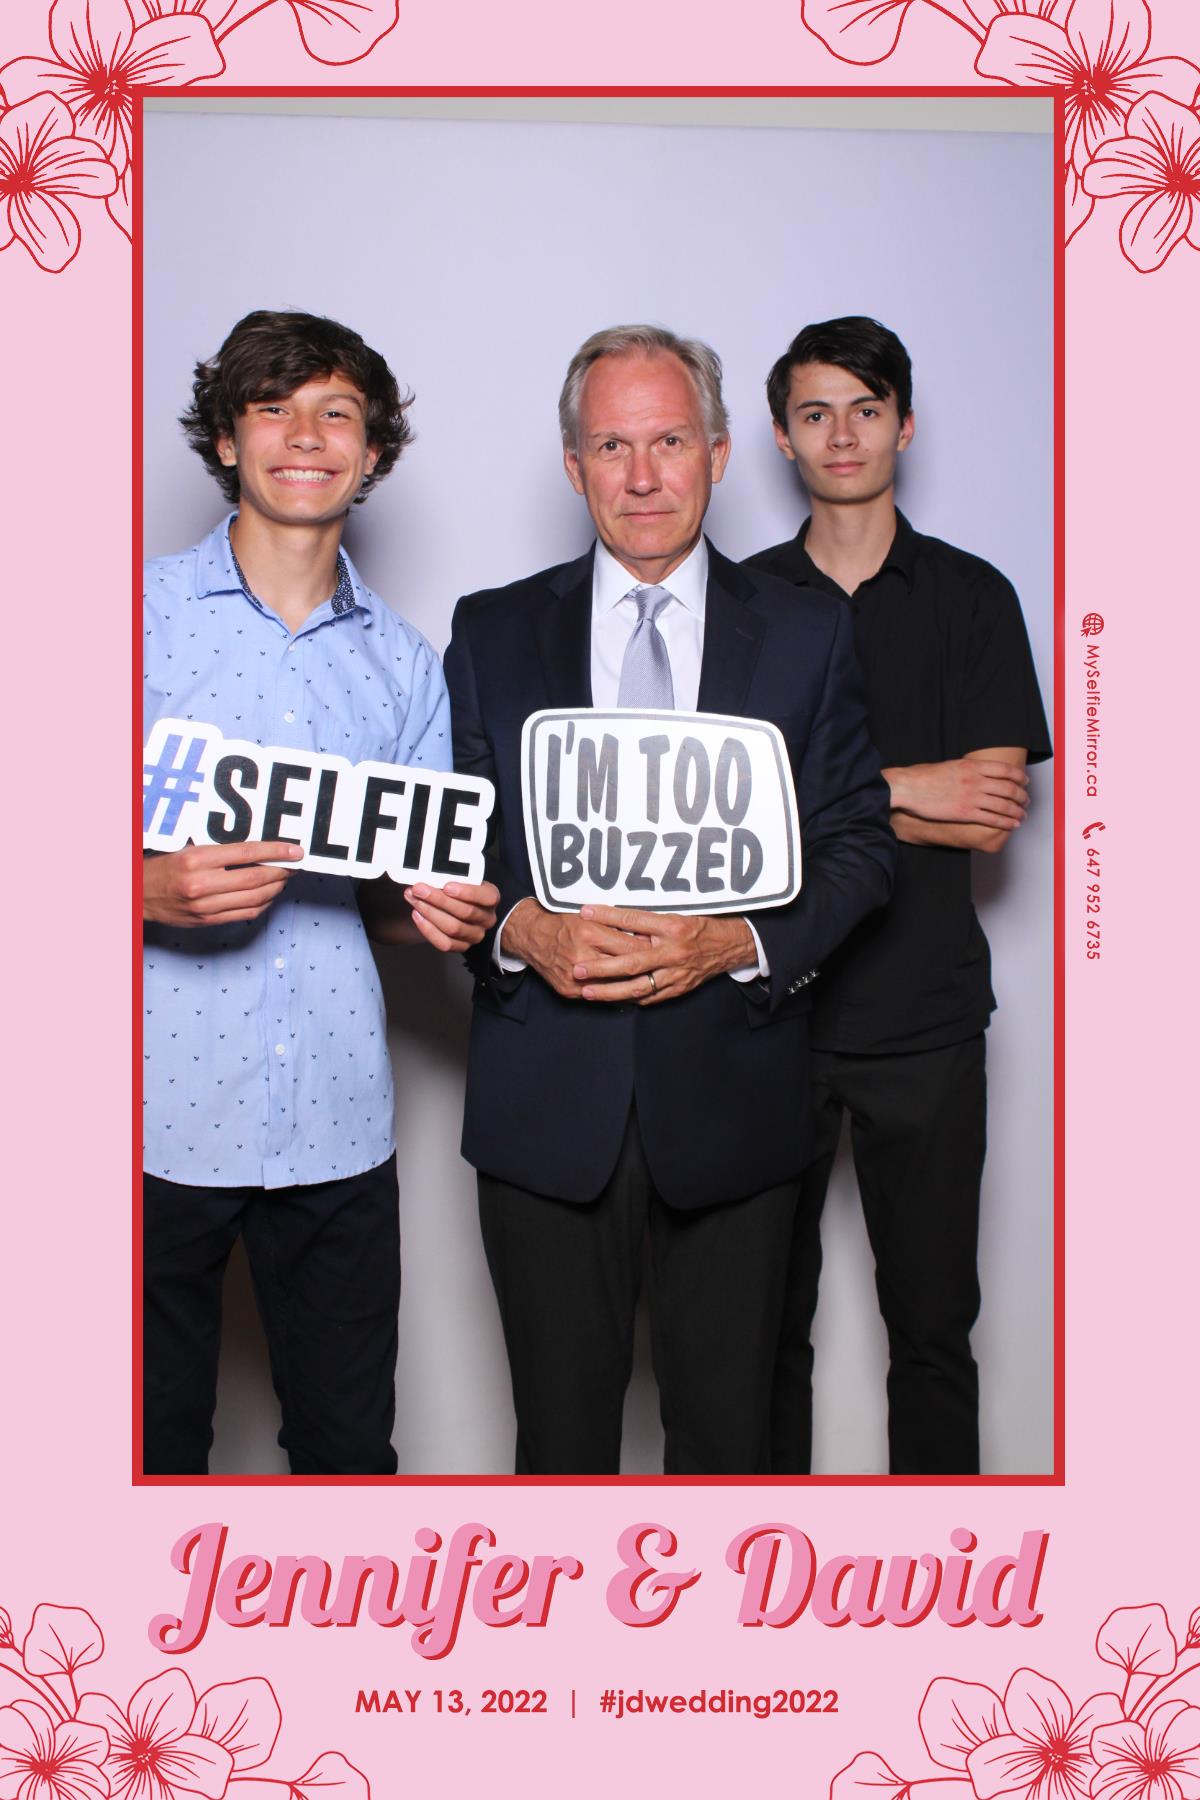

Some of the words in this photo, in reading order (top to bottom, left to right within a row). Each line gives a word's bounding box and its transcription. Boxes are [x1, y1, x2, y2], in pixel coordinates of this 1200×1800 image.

[143, 734, 481, 878] #SELFIE
[546, 721, 619, 822] I'M
[638, 734, 752, 826] TOO
[550, 823, 763, 894] BUZZED
